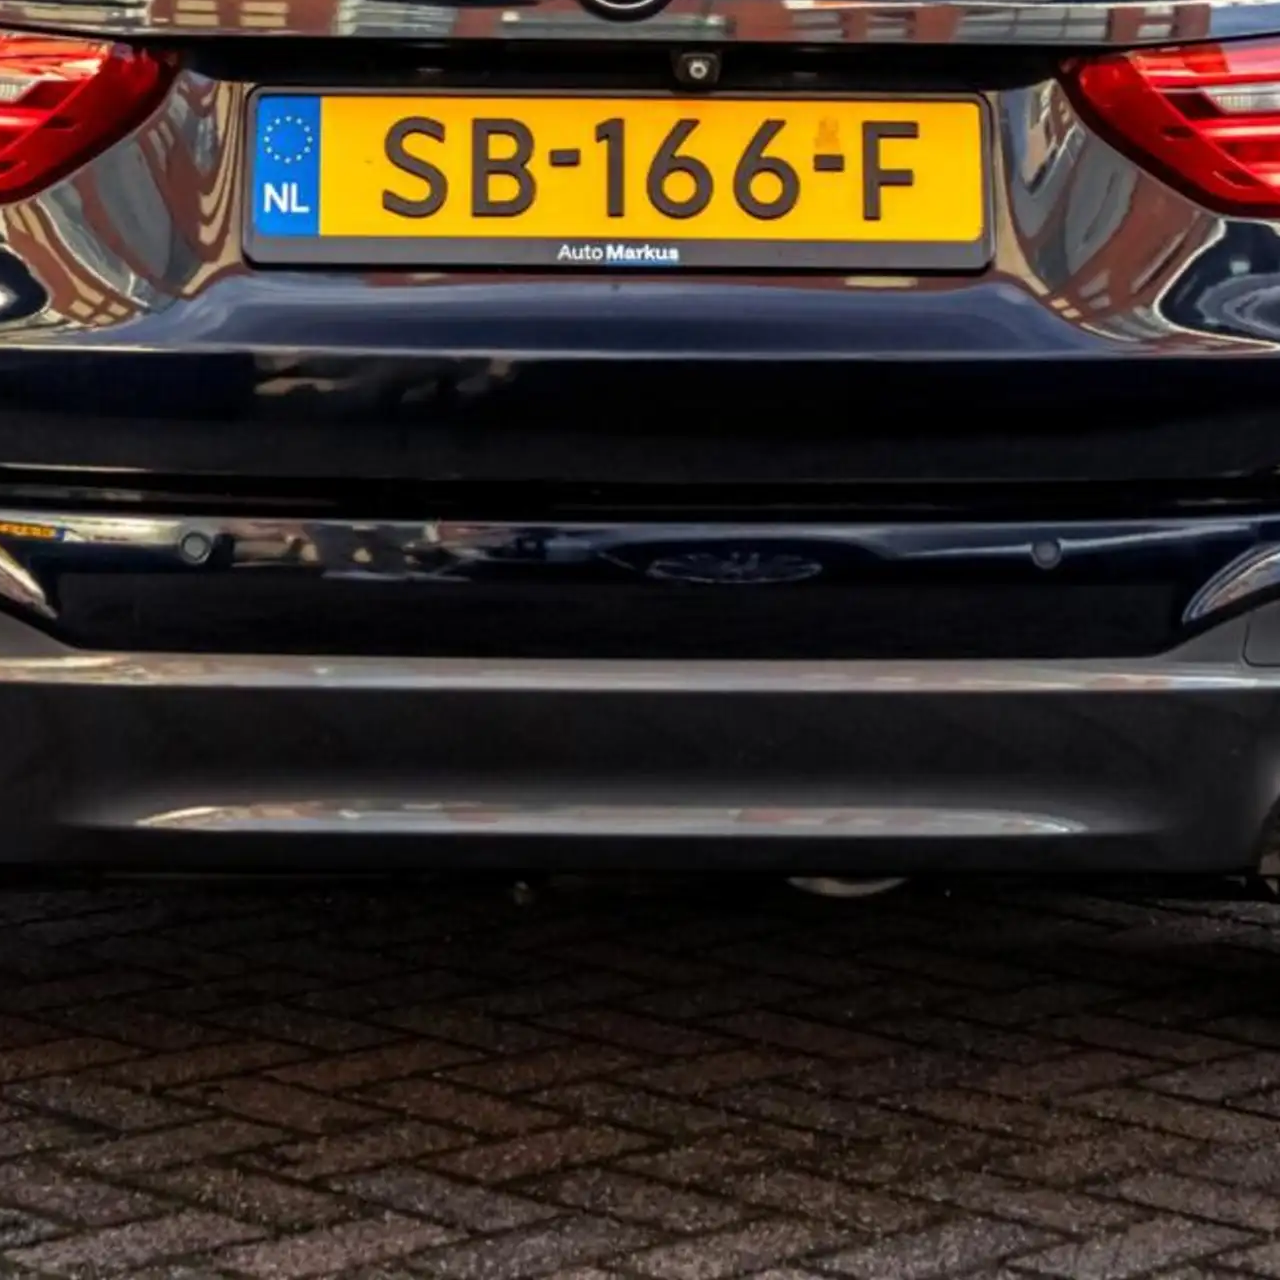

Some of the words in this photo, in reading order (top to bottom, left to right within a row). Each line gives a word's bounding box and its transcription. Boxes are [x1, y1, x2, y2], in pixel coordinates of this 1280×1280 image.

[381, 116, 921, 222] SB-166-F
[263, 182, 310, 214] NL
[557, 244, 603, 261] Auto
[606, 244, 680, 262] Markus
